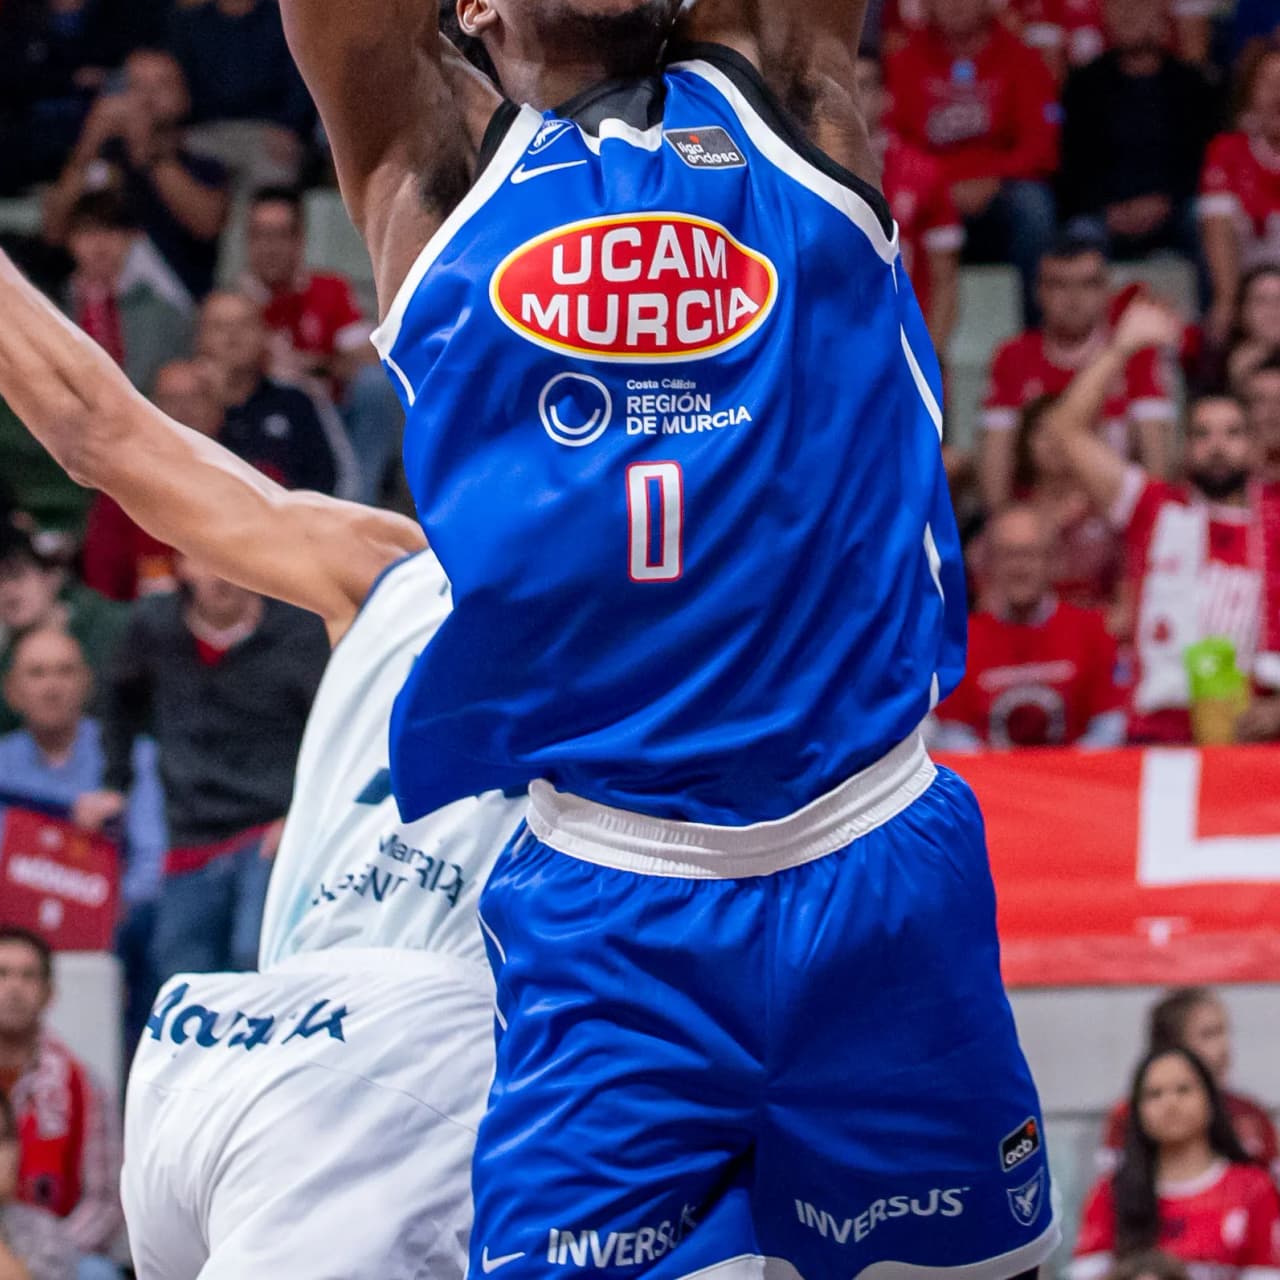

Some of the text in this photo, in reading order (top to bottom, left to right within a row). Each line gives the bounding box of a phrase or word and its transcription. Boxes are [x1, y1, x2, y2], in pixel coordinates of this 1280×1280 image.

[551, 224, 728, 286] UCAM
[521, 287, 760, 347] MURCIA
[626, 379, 659, 390] Costa
[626, 391, 711, 414] REGIÓN
[626, 405, 753, 435] DE MURCIA
[625, 460, 684, 583] 0
[1005, 1139, 1033, 1165] acb
[795, 1187, 963, 1244] INVERSUS
